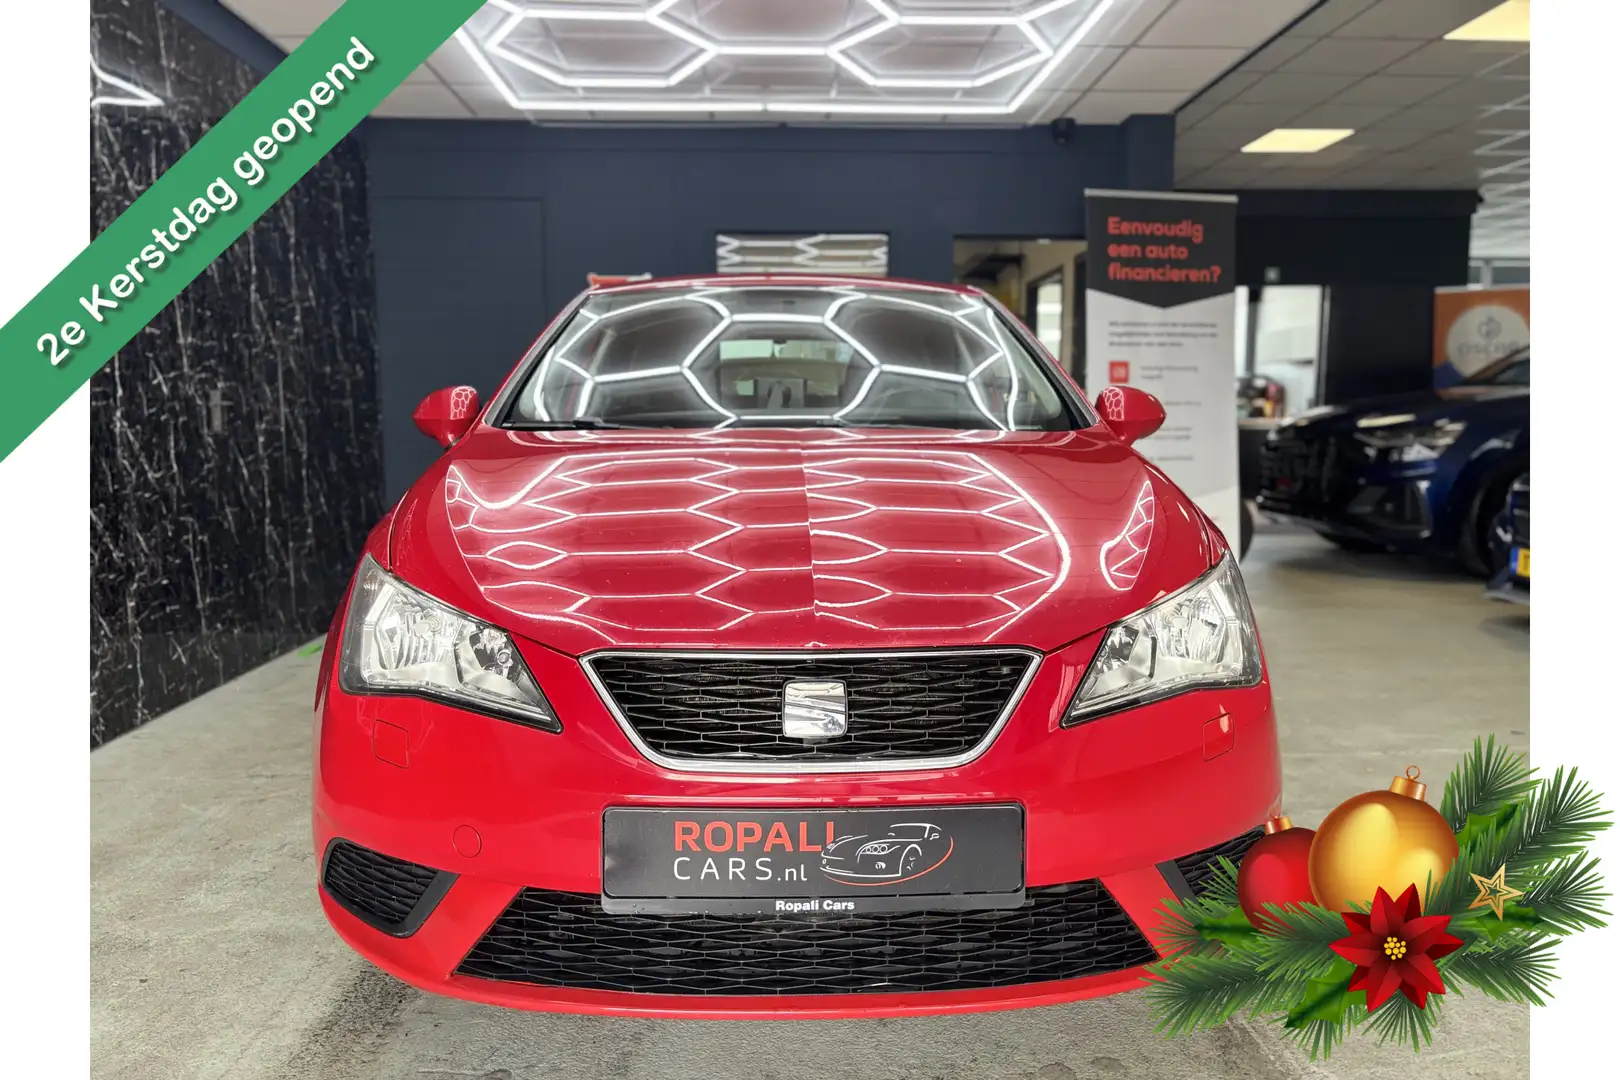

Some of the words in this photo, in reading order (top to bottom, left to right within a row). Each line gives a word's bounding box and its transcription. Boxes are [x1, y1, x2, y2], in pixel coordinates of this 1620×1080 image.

[1107, 216, 1204, 244] Eenvoudig
[1107, 243, 1142, 258] een
[1145, 242, 1189, 260] auto
[1108, 262, 1222, 284] financieren?
[674, 820, 834, 852] ROPALI
[673, 857, 808, 882] CARS.nl
[775, 900, 820, 912] Ropali
[822, 900, 855, 911] Cars
